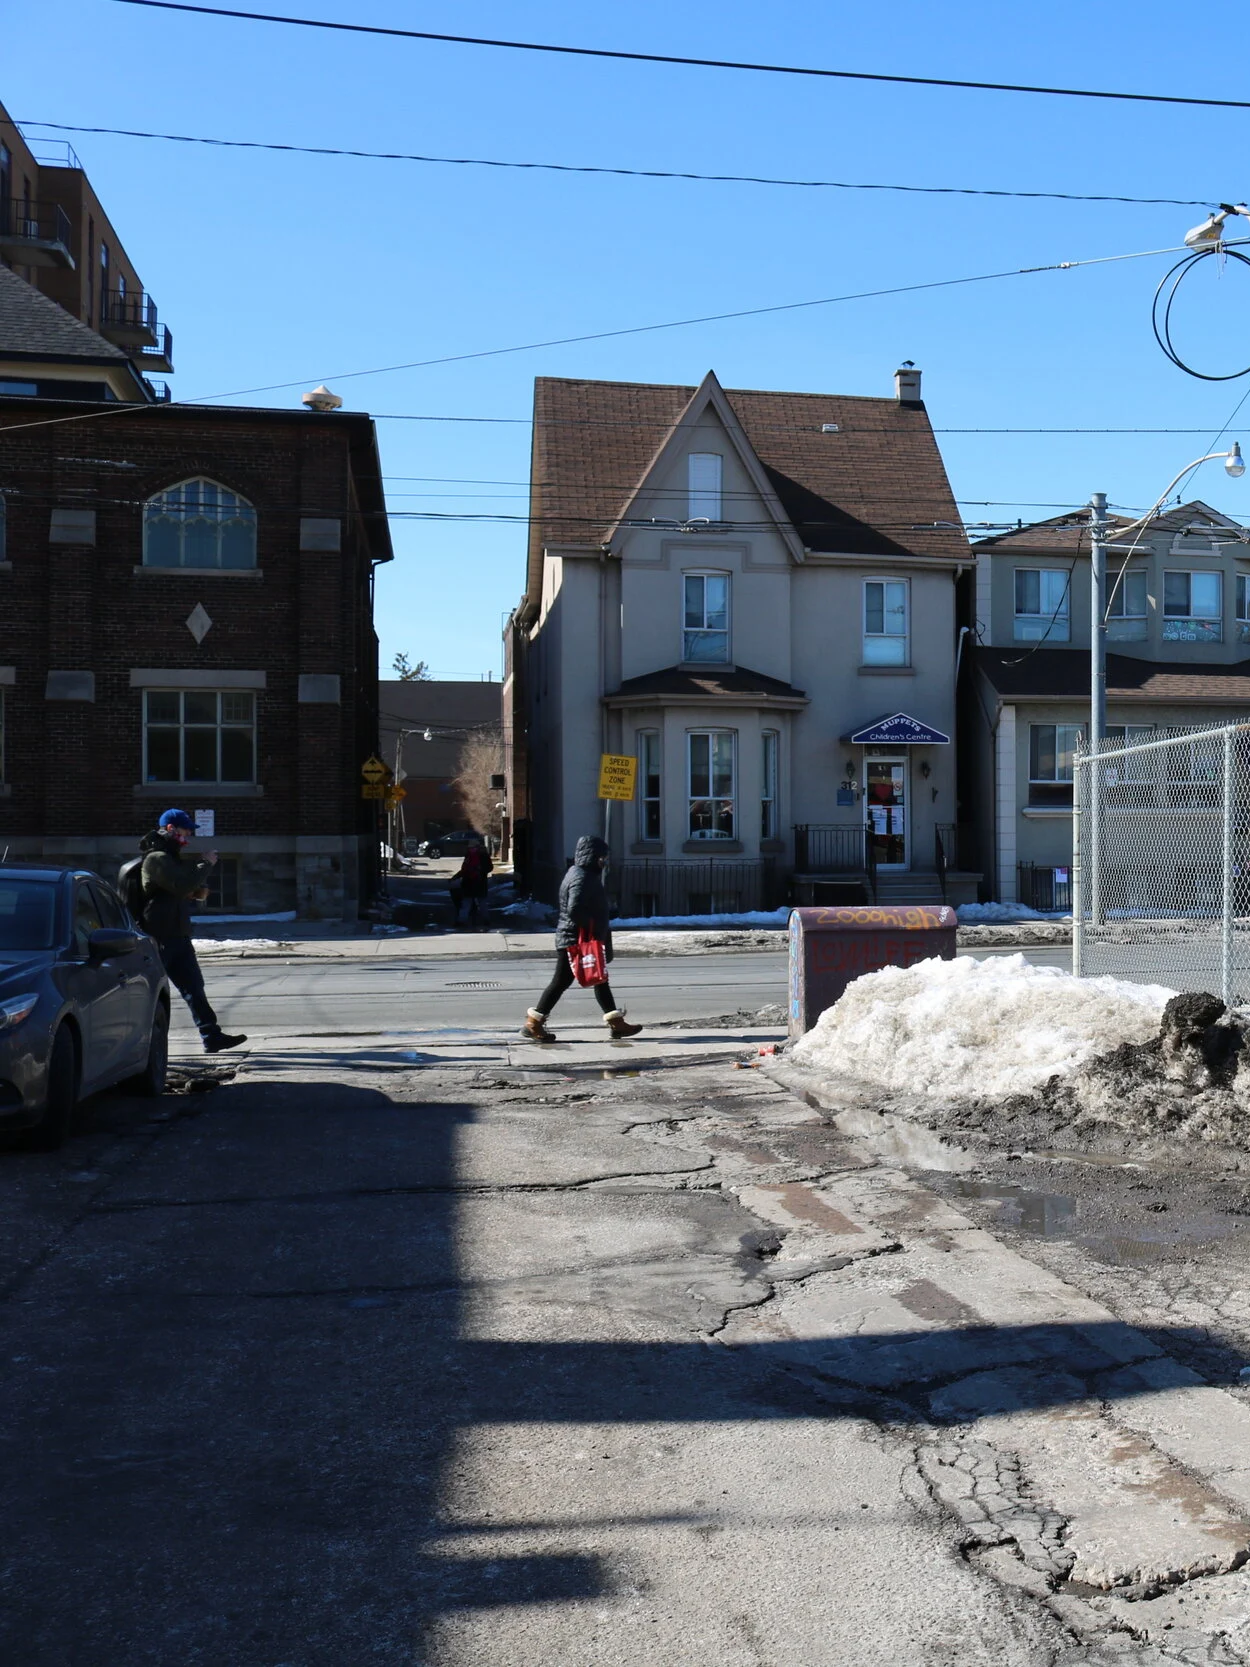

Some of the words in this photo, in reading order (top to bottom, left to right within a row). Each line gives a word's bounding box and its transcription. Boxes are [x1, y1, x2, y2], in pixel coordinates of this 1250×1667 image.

[881, 717, 921, 732] MUPPETS
[609, 757, 630, 767] SPEED
[604, 766, 632, 776] CONTROL
[609, 776, 625, 785] ZONE
[841, 781, 858, 790] 312
